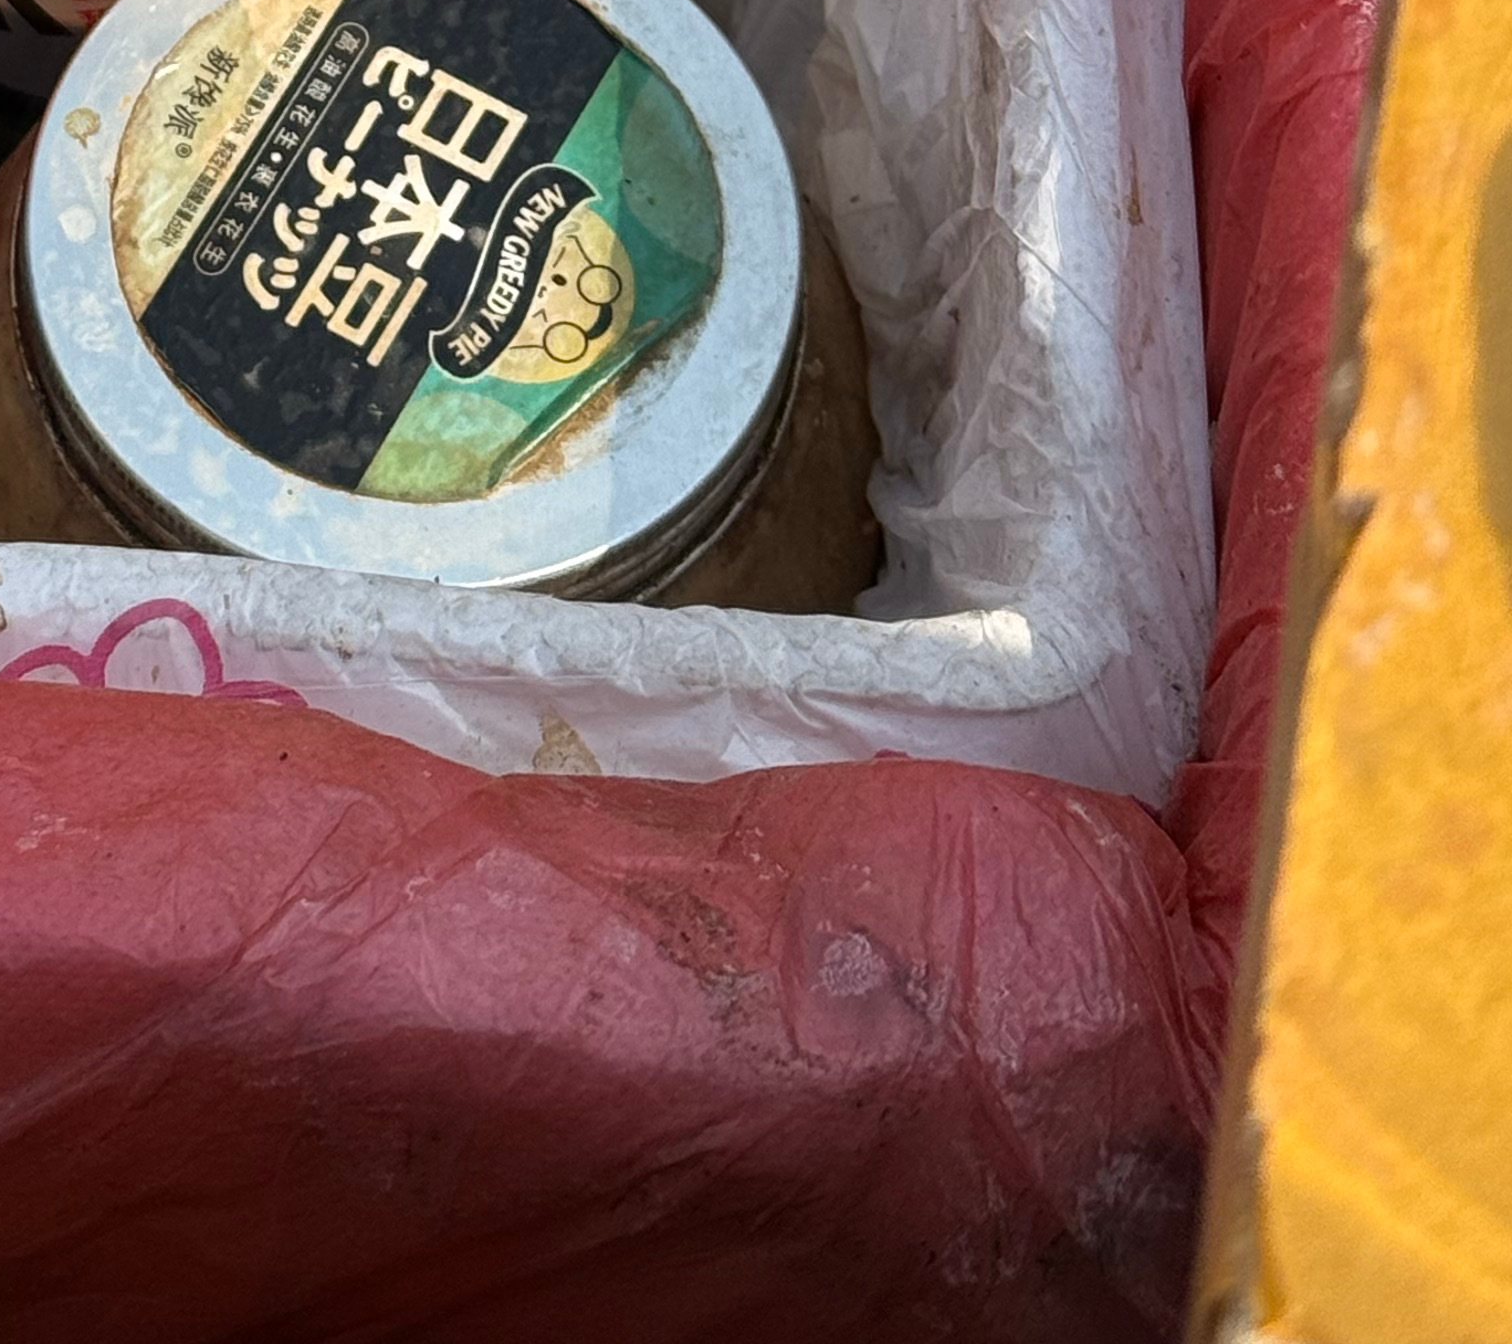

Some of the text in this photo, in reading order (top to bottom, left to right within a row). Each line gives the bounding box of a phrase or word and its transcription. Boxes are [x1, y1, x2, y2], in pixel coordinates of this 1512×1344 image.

[241, 45, 431, 311] ピーナッツ
[284, 64, 529, 368] 日本豆
[448, 184, 567, 366] NEW GREEDY PIE
